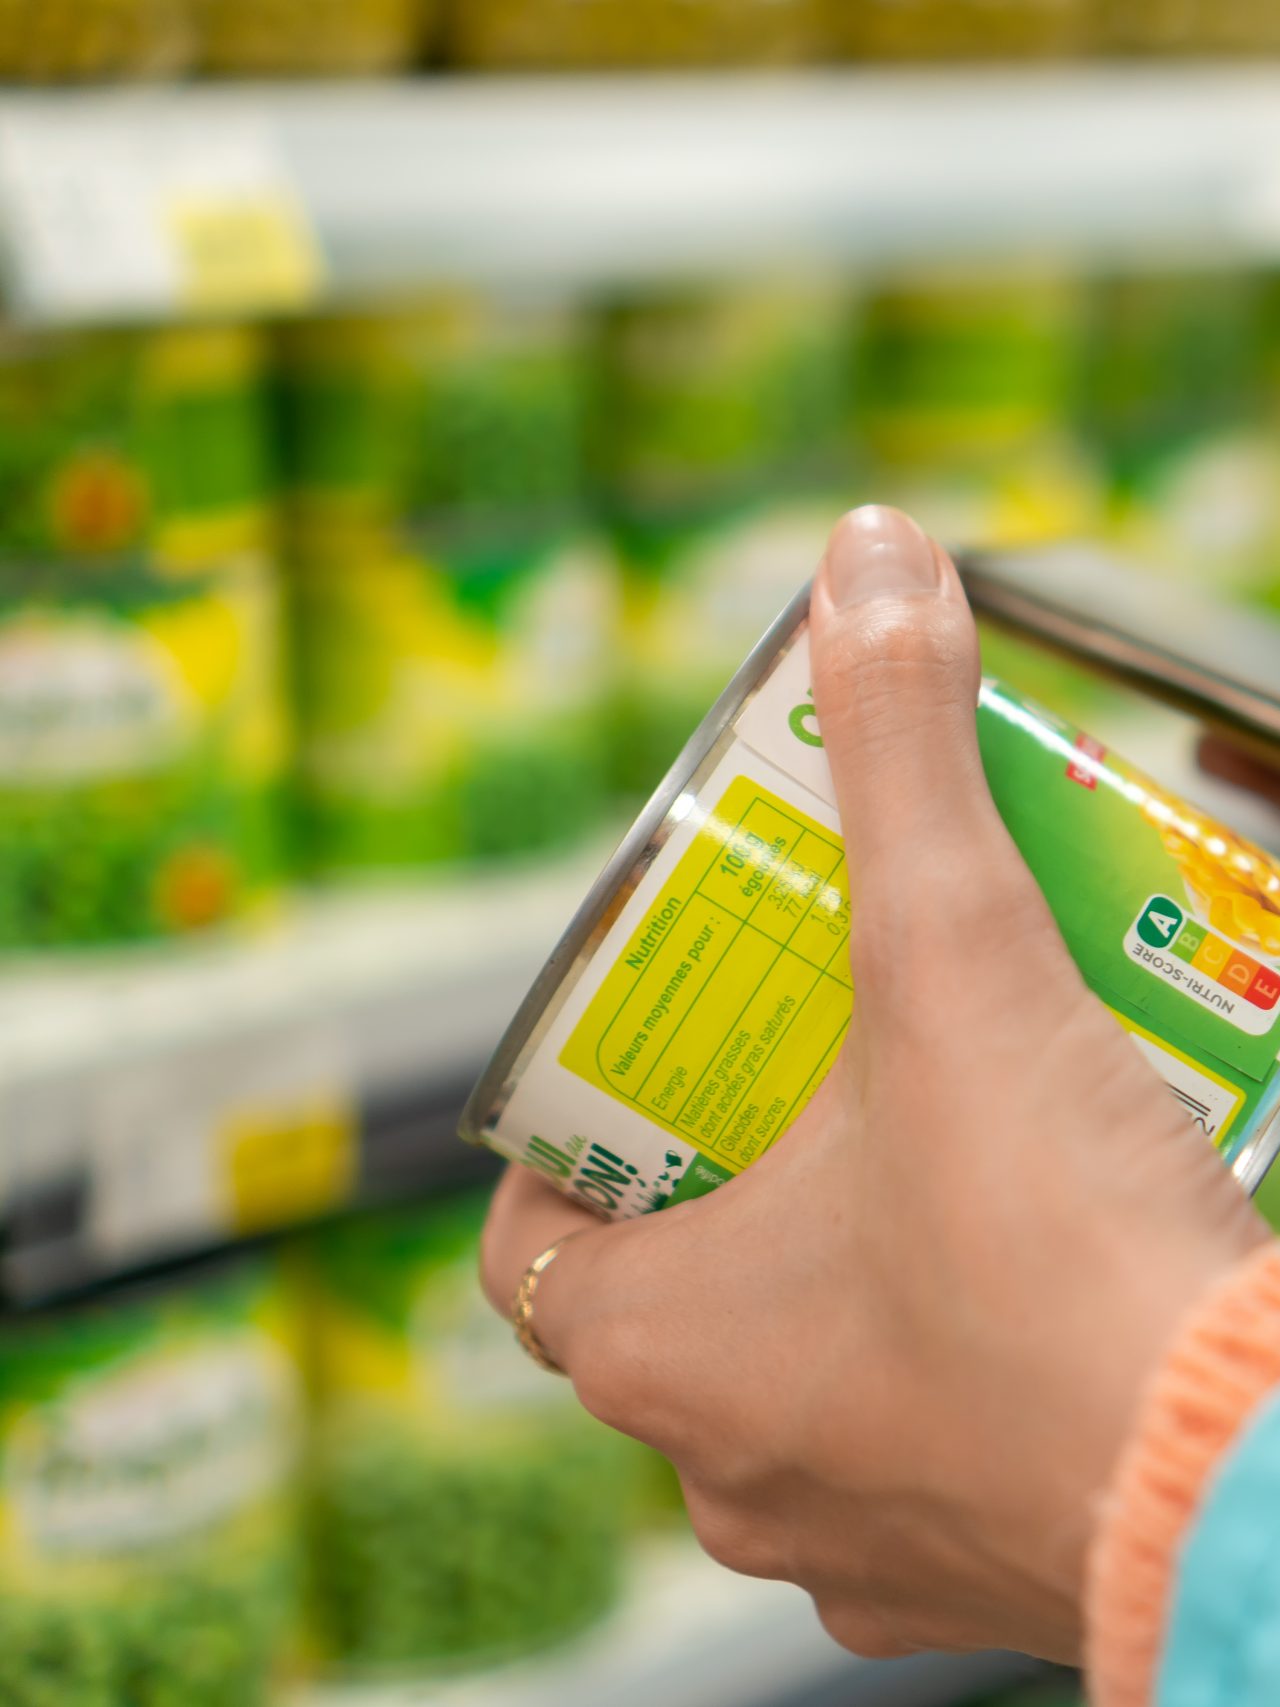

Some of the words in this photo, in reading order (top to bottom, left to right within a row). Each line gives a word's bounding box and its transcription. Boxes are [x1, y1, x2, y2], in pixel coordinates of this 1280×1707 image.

[720, 842, 752, 877] 100
[625, 897, 682, 970] Nutrition
[782, 896, 802, 918] 77
[1132, 942, 1235, 1014] NUTRI-SCORE
[1147, 910, 1179, 939] A
[1178, 932, 1201, 952] B
[1202, 945, 1223, 965] C
[1227, 963, 1250, 985] D
[1254, 978, 1278, 1000] E
[610, 1031, 648, 1076] Valeurs
[643, 961, 692, 1031] moyennes
[688, 924, 714, 962] pour
[680, 1079, 720, 1129] Matières
[714, 1030, 751, 1081] grasses
[700, 1109, 723, 1139] dont
[716, 1072, 747, 1114] acides
[741, 1043, 766, 1077] gras
[760, 995, 796, 1045] saturés
[514, 1135, 577, 1190] UI
[720, 1103, 760, 1152] Glucides
[739, 1134, 761, 1163] dont
[755, 1096, 787, 1138] sucres
